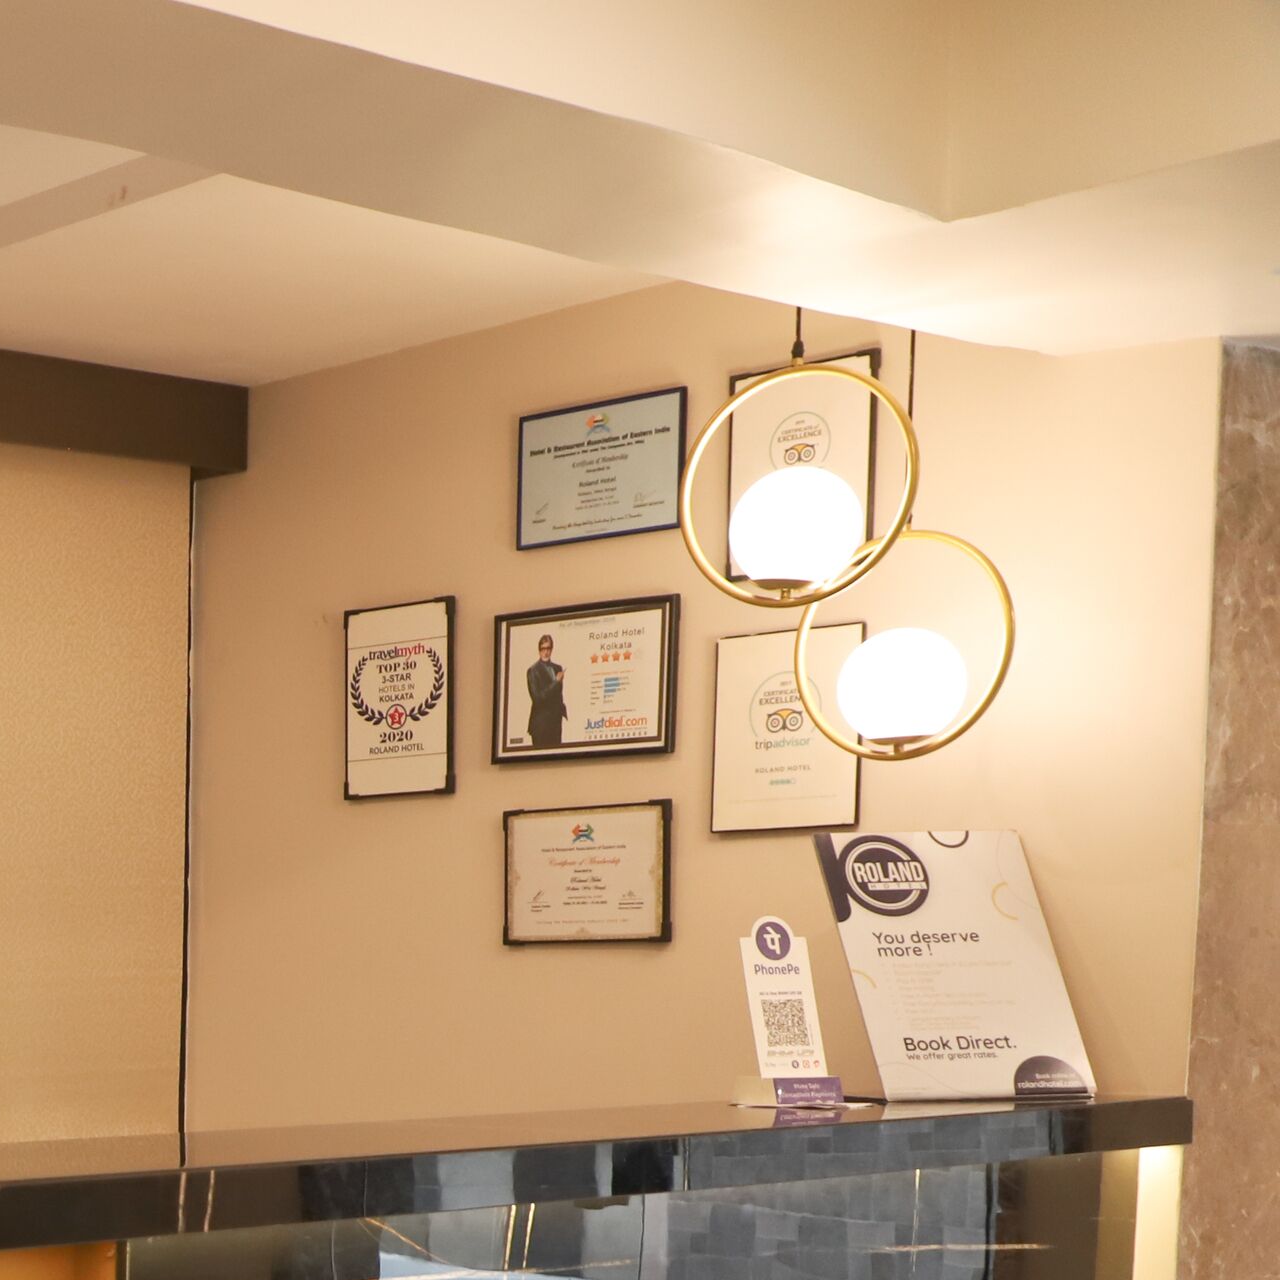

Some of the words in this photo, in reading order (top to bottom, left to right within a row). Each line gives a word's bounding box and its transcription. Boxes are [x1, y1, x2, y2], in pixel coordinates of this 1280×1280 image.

[589, 630, 619, 640] Roland
[621, 627, 645, 637] Hotel
[368, 643, 425, 661] travelmyth
[600, 641, 632, 652] Kolkata
[376, 661, 400, 674] TOP
[402, 660, 417, 671] 30
[381, 673, 411, 684] 3-STAR
[378, 684, 406, 693] HOTELS
[763, 688, 798, 697] CERTIFICAT
[379, 692, 415, 703] KOLKATA
[584, 716, 648, 730] Justdial.com
[379, 729, 414, 744] 2020
[369, 744, 400, 755] ROLAND
[401, 743, 425, 753] HOTEL
[755, 737, 810, 751] tripadvisor
[787, 764, 811, 773] HOTEL
[853, 861, 925, 883] ROLAND
[871, 931, 905, 944] You
[910, 930, 980, 944] deserve
[877, 945, 923, 957] more
[753, 963, 800, 975] PhonePe
[903, 1036, 952, 1051] Book
[956, 1034, 1018, 1050] Direct.
[906, 1053, 921, 1061] We
[922, 1052, 945, 1060] offer
[948, 1052, 972, 1061] great
[973, 1051, 999, 1059] rates.
